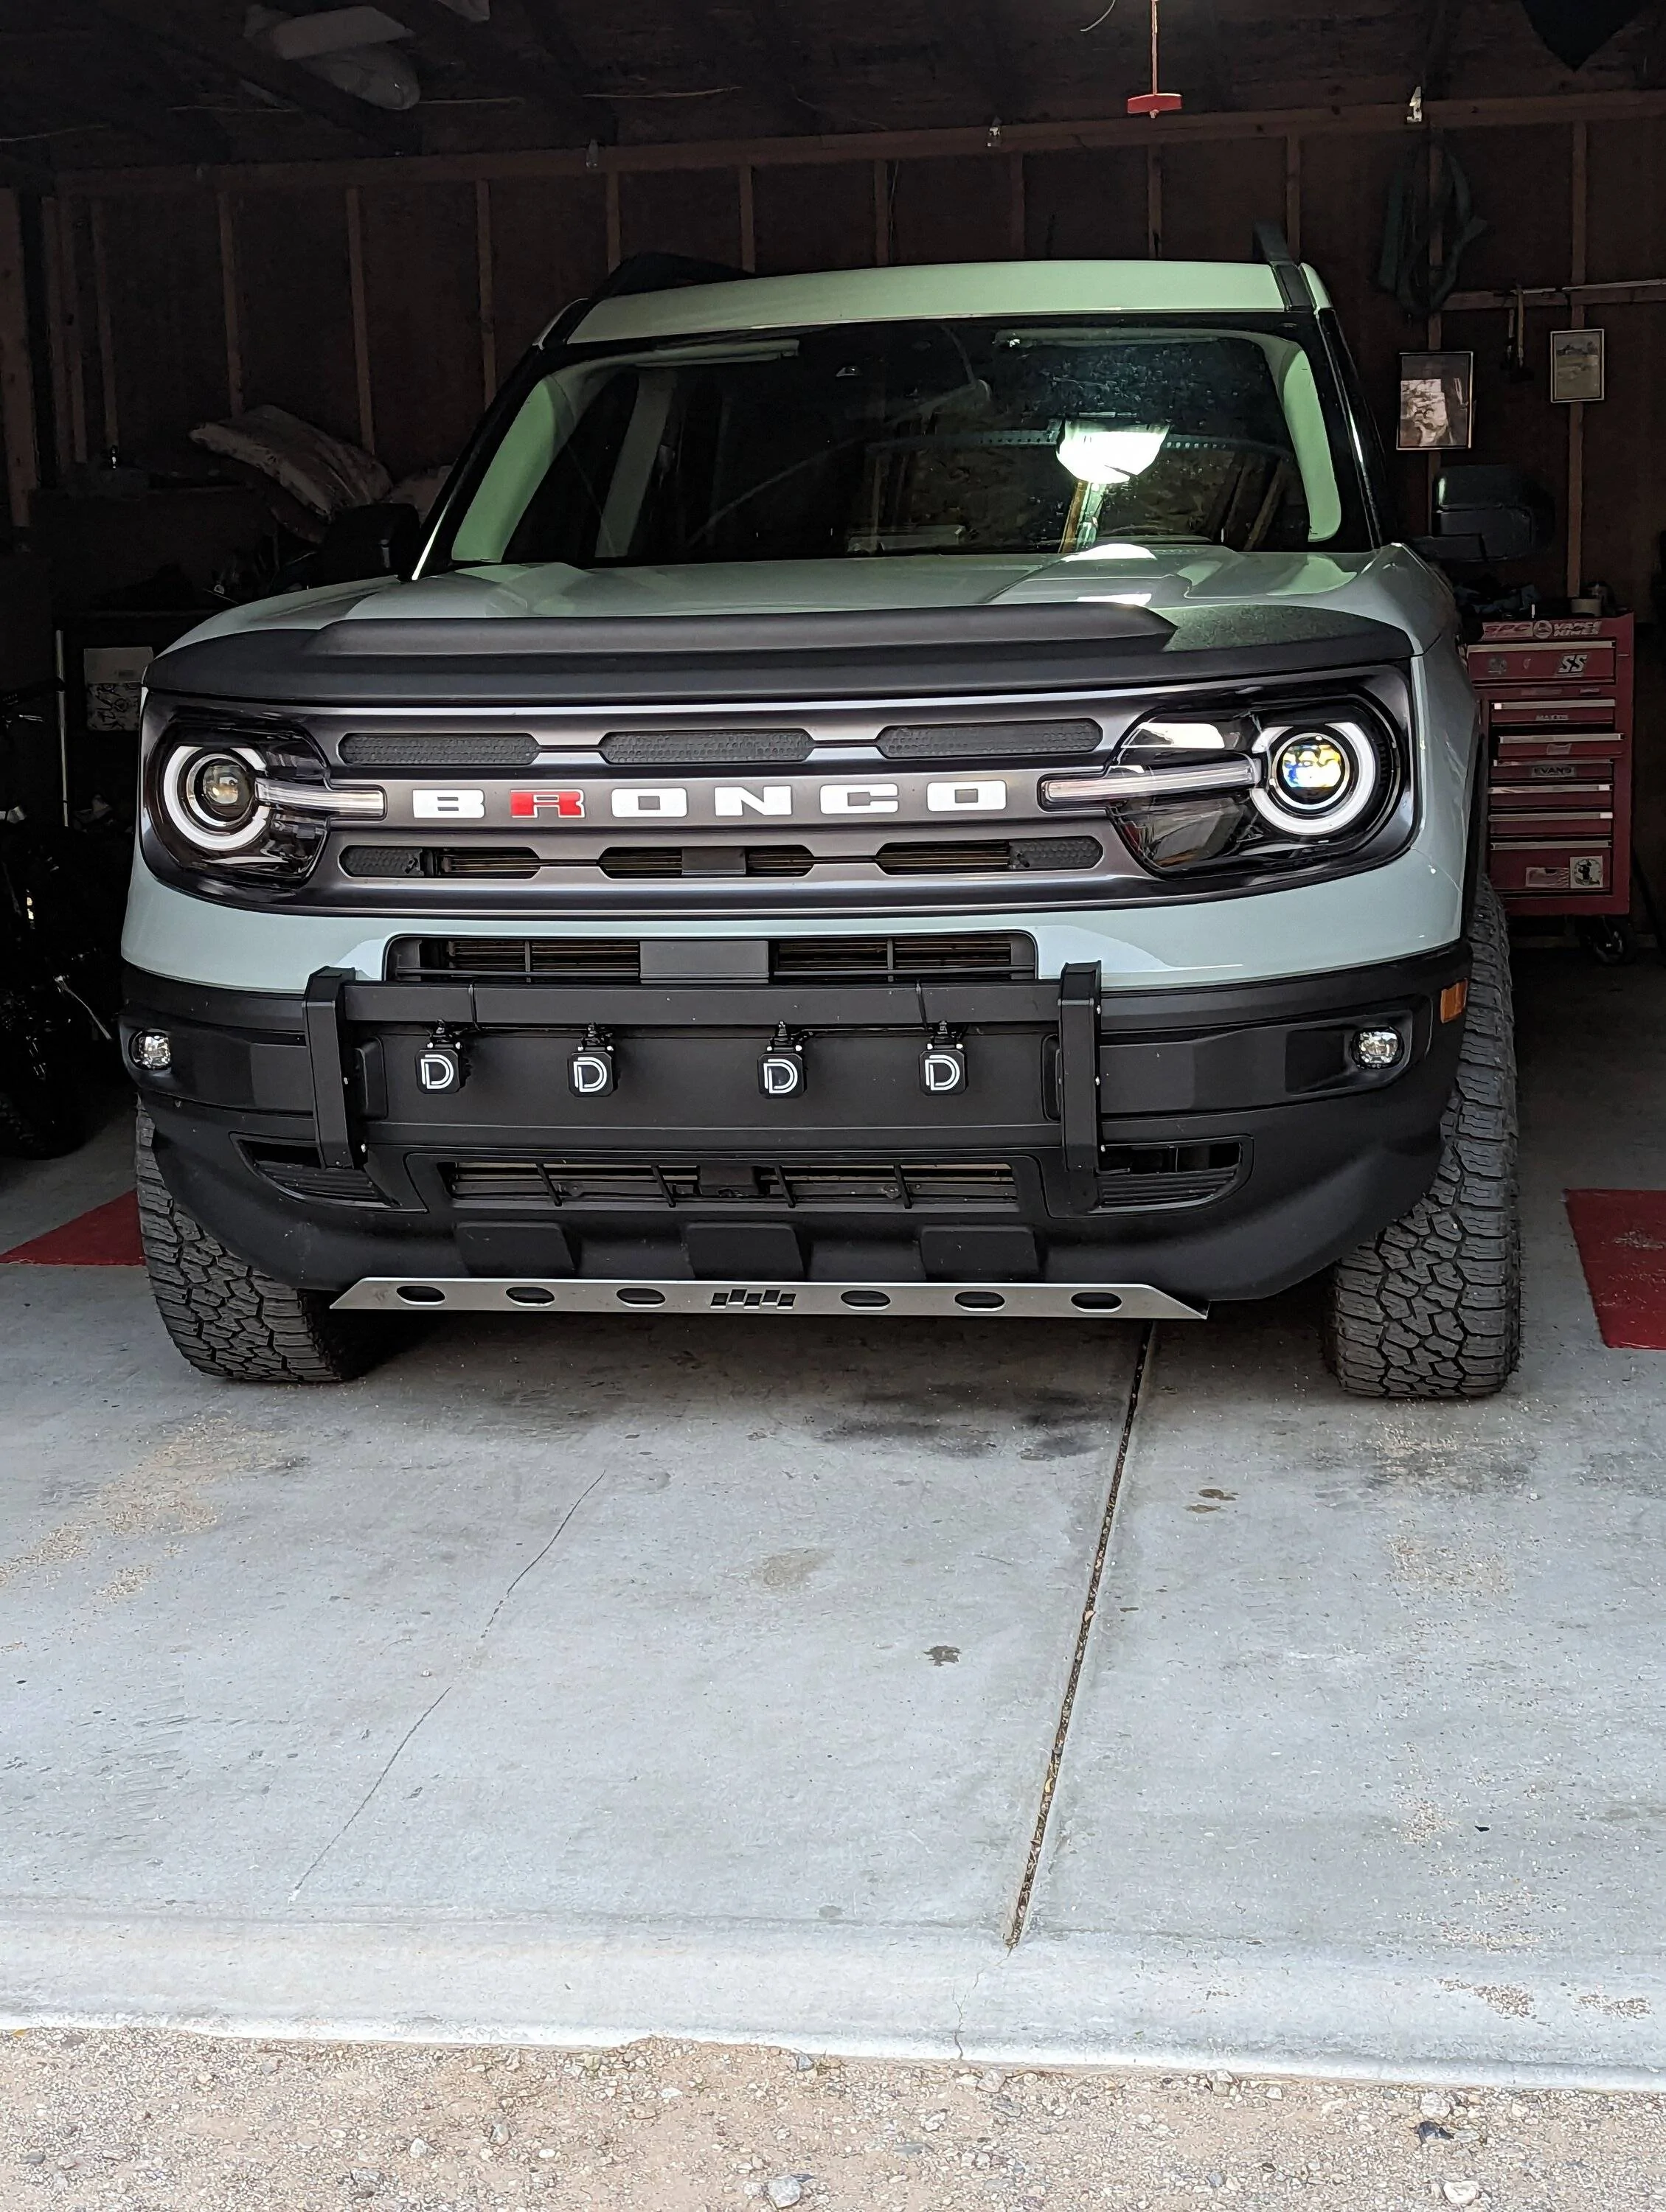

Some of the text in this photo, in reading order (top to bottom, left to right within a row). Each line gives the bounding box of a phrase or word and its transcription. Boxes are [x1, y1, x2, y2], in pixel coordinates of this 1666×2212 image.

[1558, 654, 1589, 672] SS
[412, 779, 1007, 819] BRONCO
[420, 1054, 454, 1089] D
[574, 1057, 608, 1093] D
[763, 1058, 799, 1094] D
[926, 1055, 961, 1091] D
